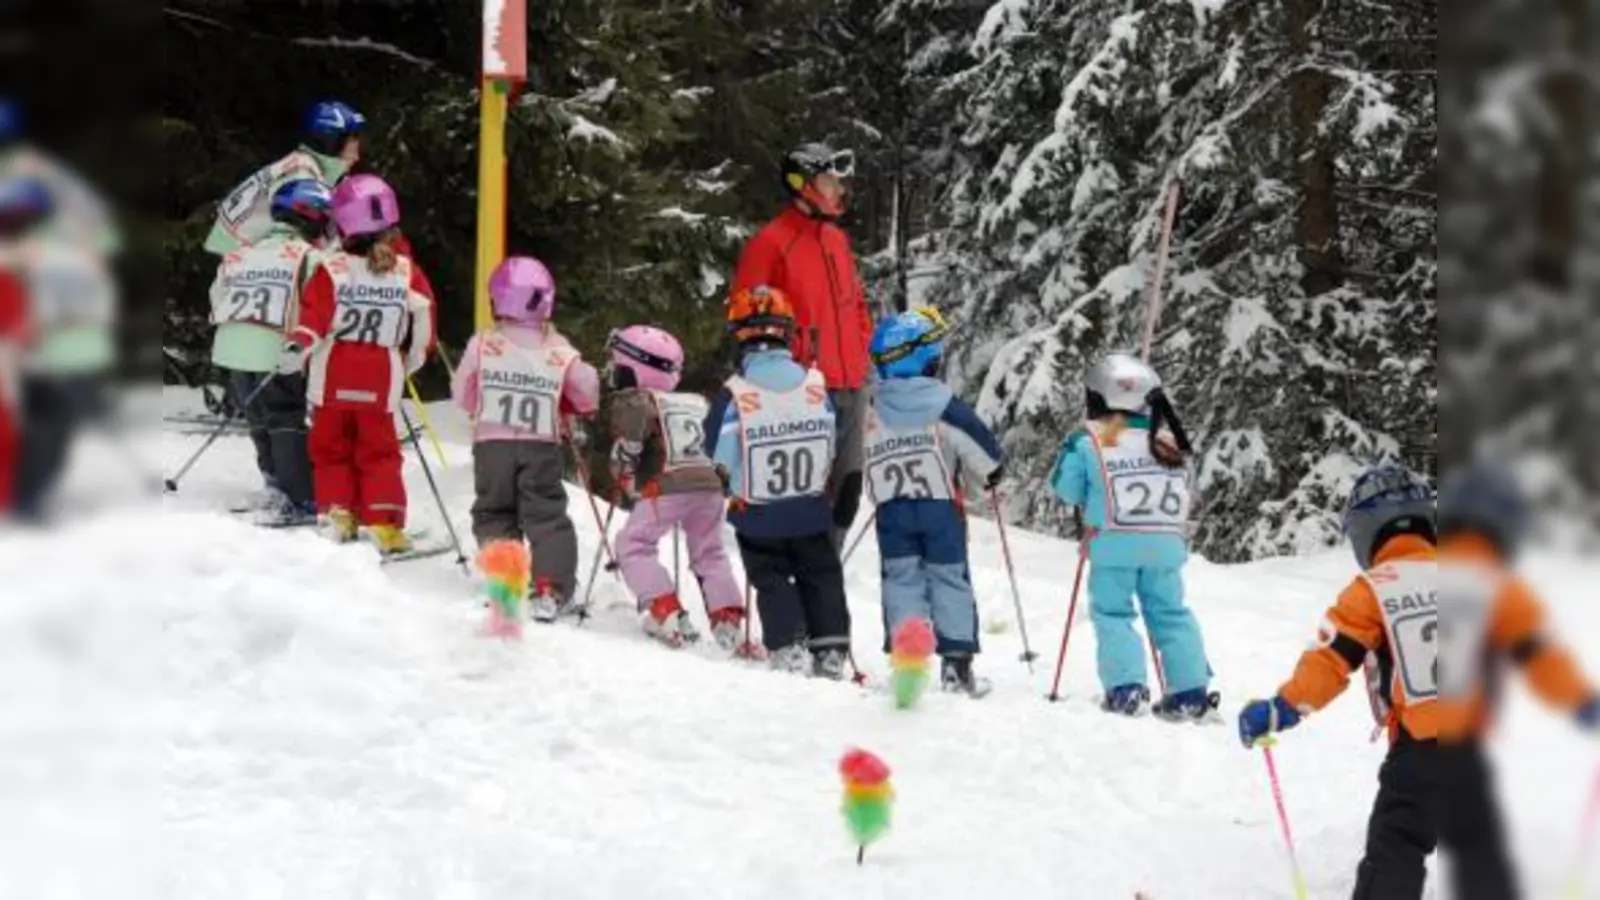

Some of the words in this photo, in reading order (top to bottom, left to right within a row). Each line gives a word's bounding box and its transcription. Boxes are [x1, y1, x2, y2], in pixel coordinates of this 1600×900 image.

[229, 287, 270, 322] 23
[332, 308, 383, 342] 28
[482, 368, 559, 391] SALOMON
[498, 393, 539, 433] 19
[746, 420, 829, 440] SALOMON
[766, 447, 814, 496] 30
[883, 460, 934, 499] 25
[1125, 480, 1181, 517] 26
